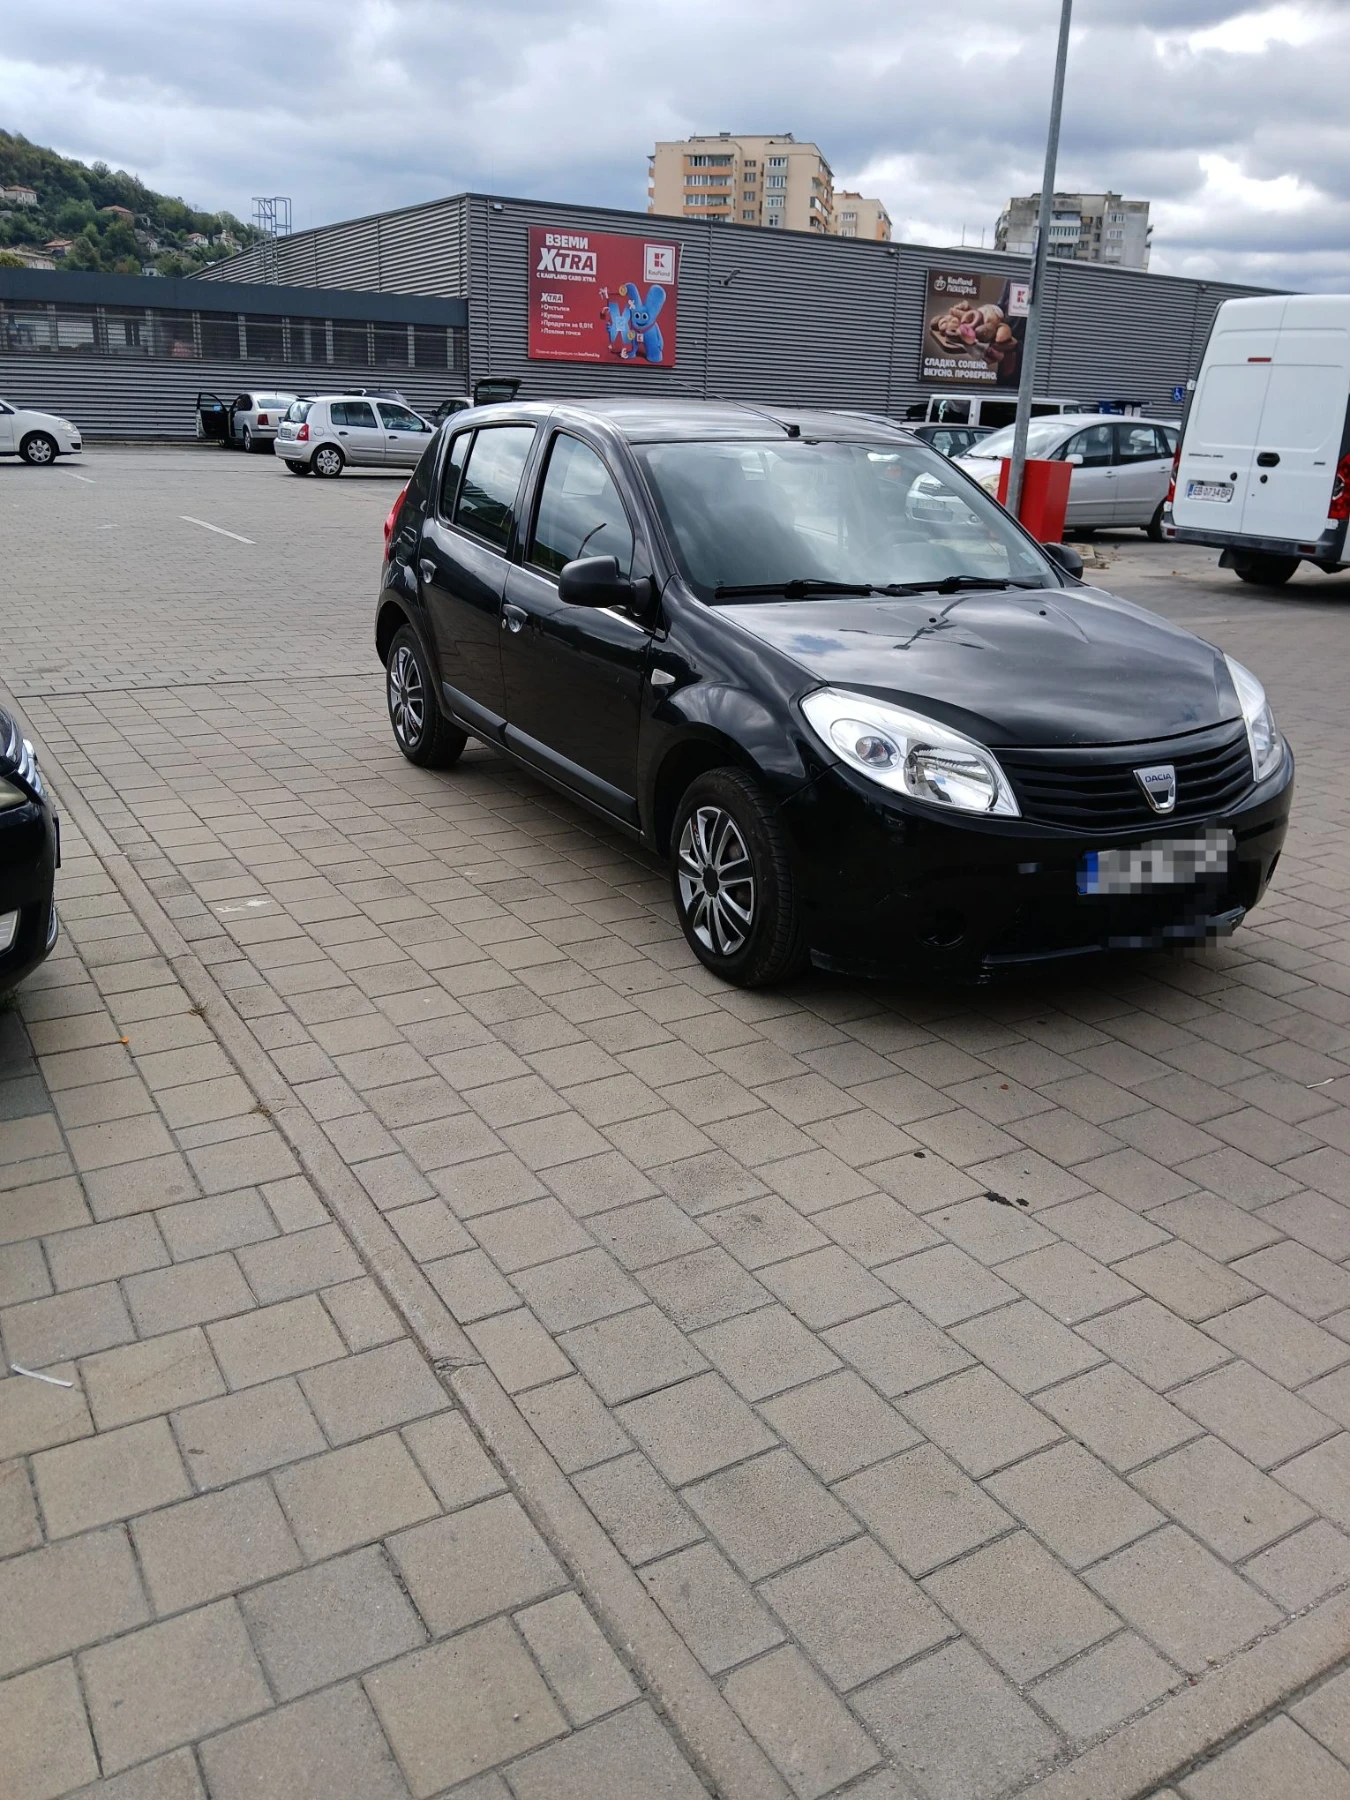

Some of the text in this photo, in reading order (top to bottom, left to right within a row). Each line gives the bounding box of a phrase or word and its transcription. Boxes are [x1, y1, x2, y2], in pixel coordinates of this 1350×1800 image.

[545, 233, 588, 250] ВЗЕМИ
[536, 247, 597, 275] XTRA
[541, 272, 567, 280] KAUFLAND
[540, 292, 563, 303] XTRA
[924, 357, 988, 370] СЛАДКО. СОЛЕНО.
[923, 368, 997, 380] ВКУСНО. ПРОВЕРЕНО.
[1144, 773, 1172, 784] DACIA
